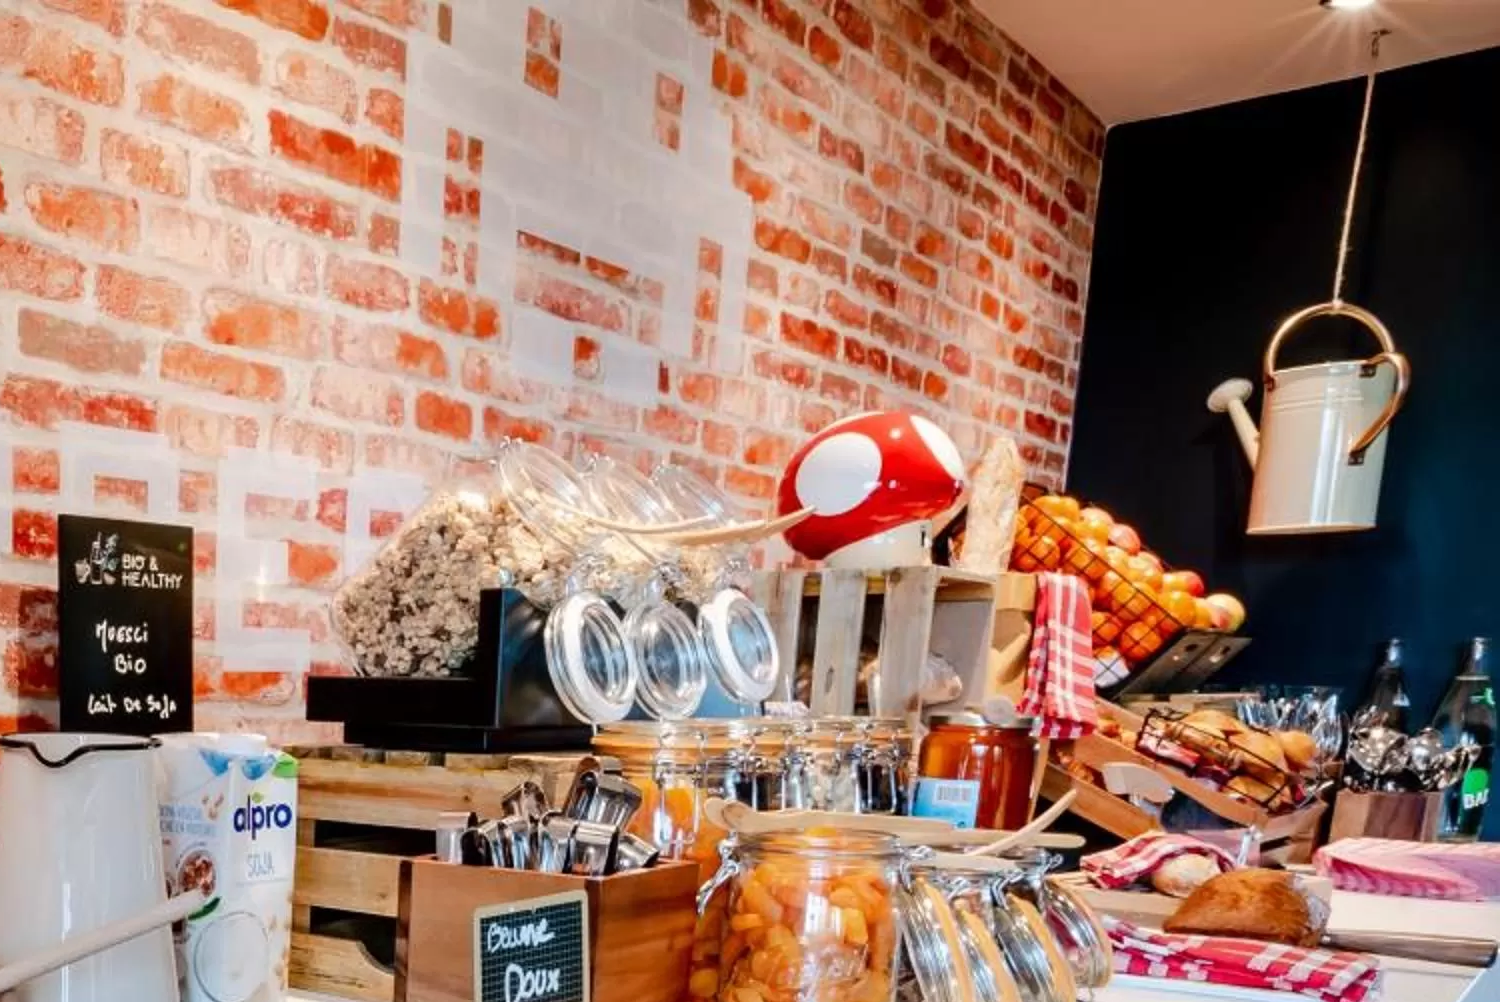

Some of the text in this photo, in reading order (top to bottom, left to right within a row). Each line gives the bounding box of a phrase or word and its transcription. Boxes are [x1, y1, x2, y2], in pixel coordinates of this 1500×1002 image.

[122, 554, 159, 571] BIO &
[122, 571, 183, 589] HEALTHY
[233, 794, 293, 840] alpro
